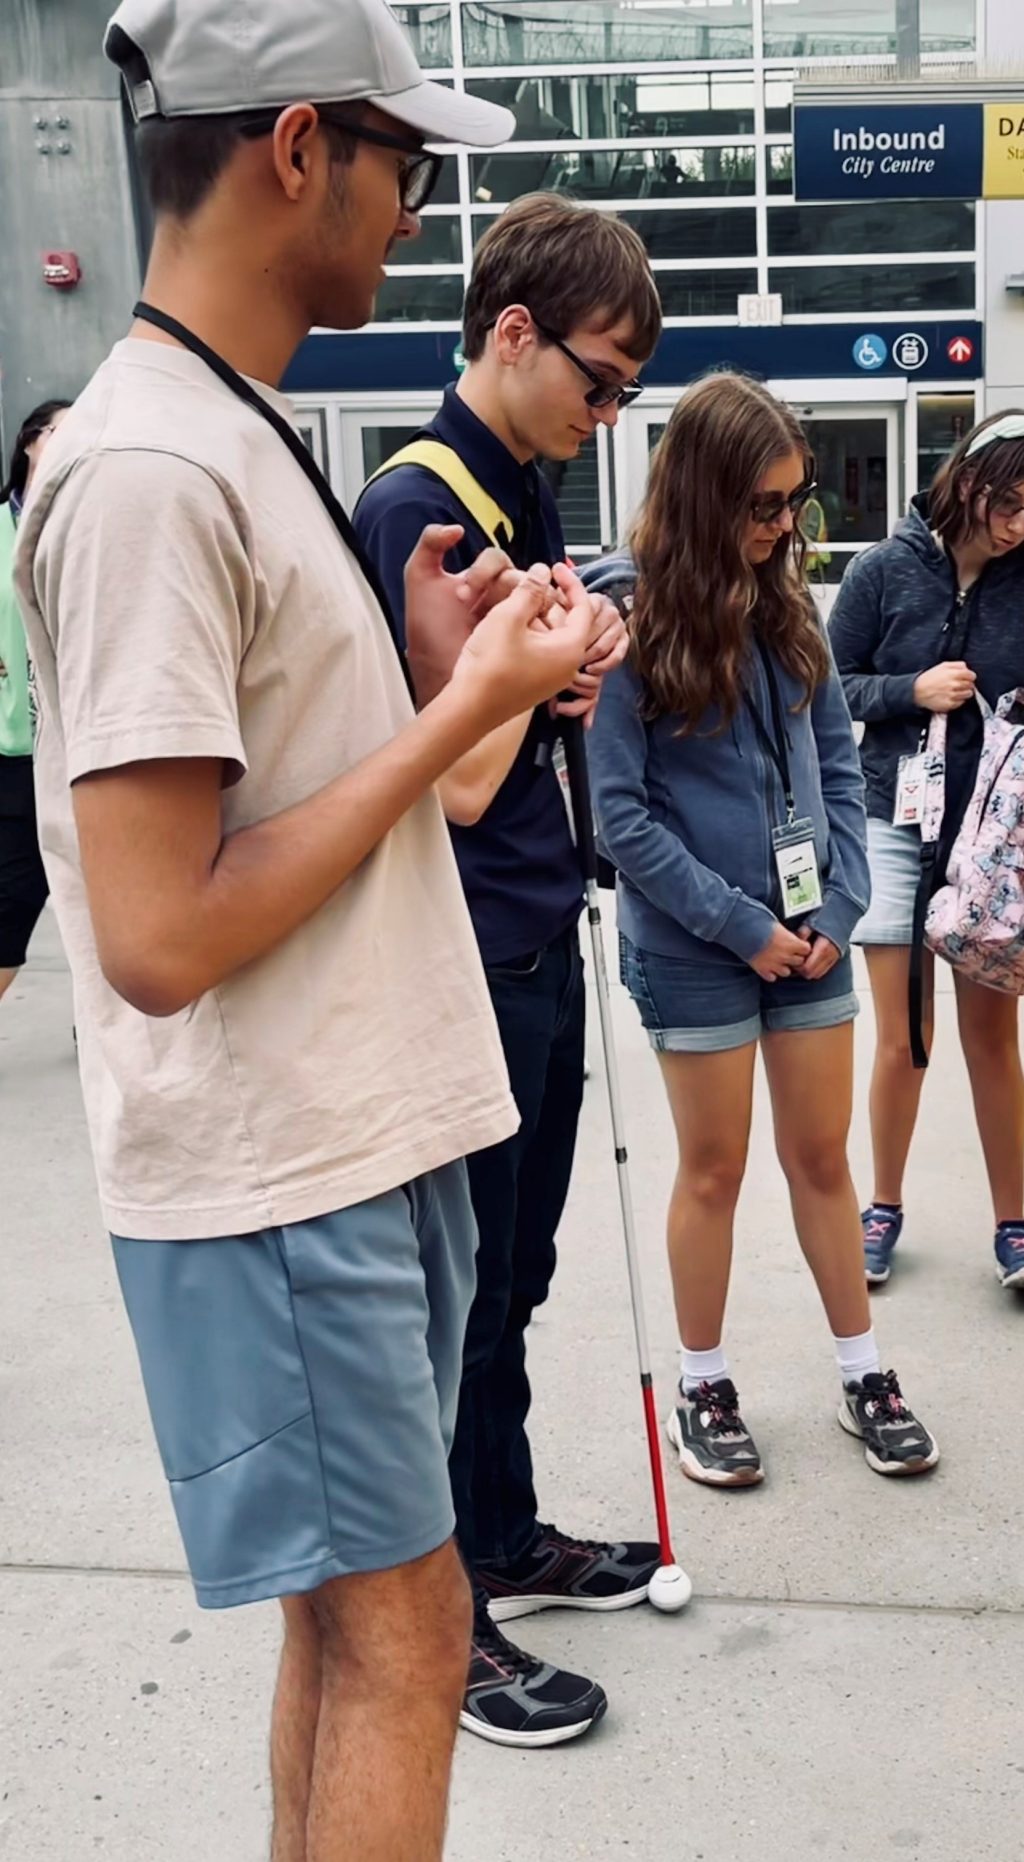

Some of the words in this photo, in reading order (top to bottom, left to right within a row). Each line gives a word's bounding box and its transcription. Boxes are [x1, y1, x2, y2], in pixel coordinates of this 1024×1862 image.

[833, 124, 945, 151] Inbound
[842, 156, 874, 178] City
[880, 156, 935, 173] Centre
[747, 299, 776, 321] EXIT
